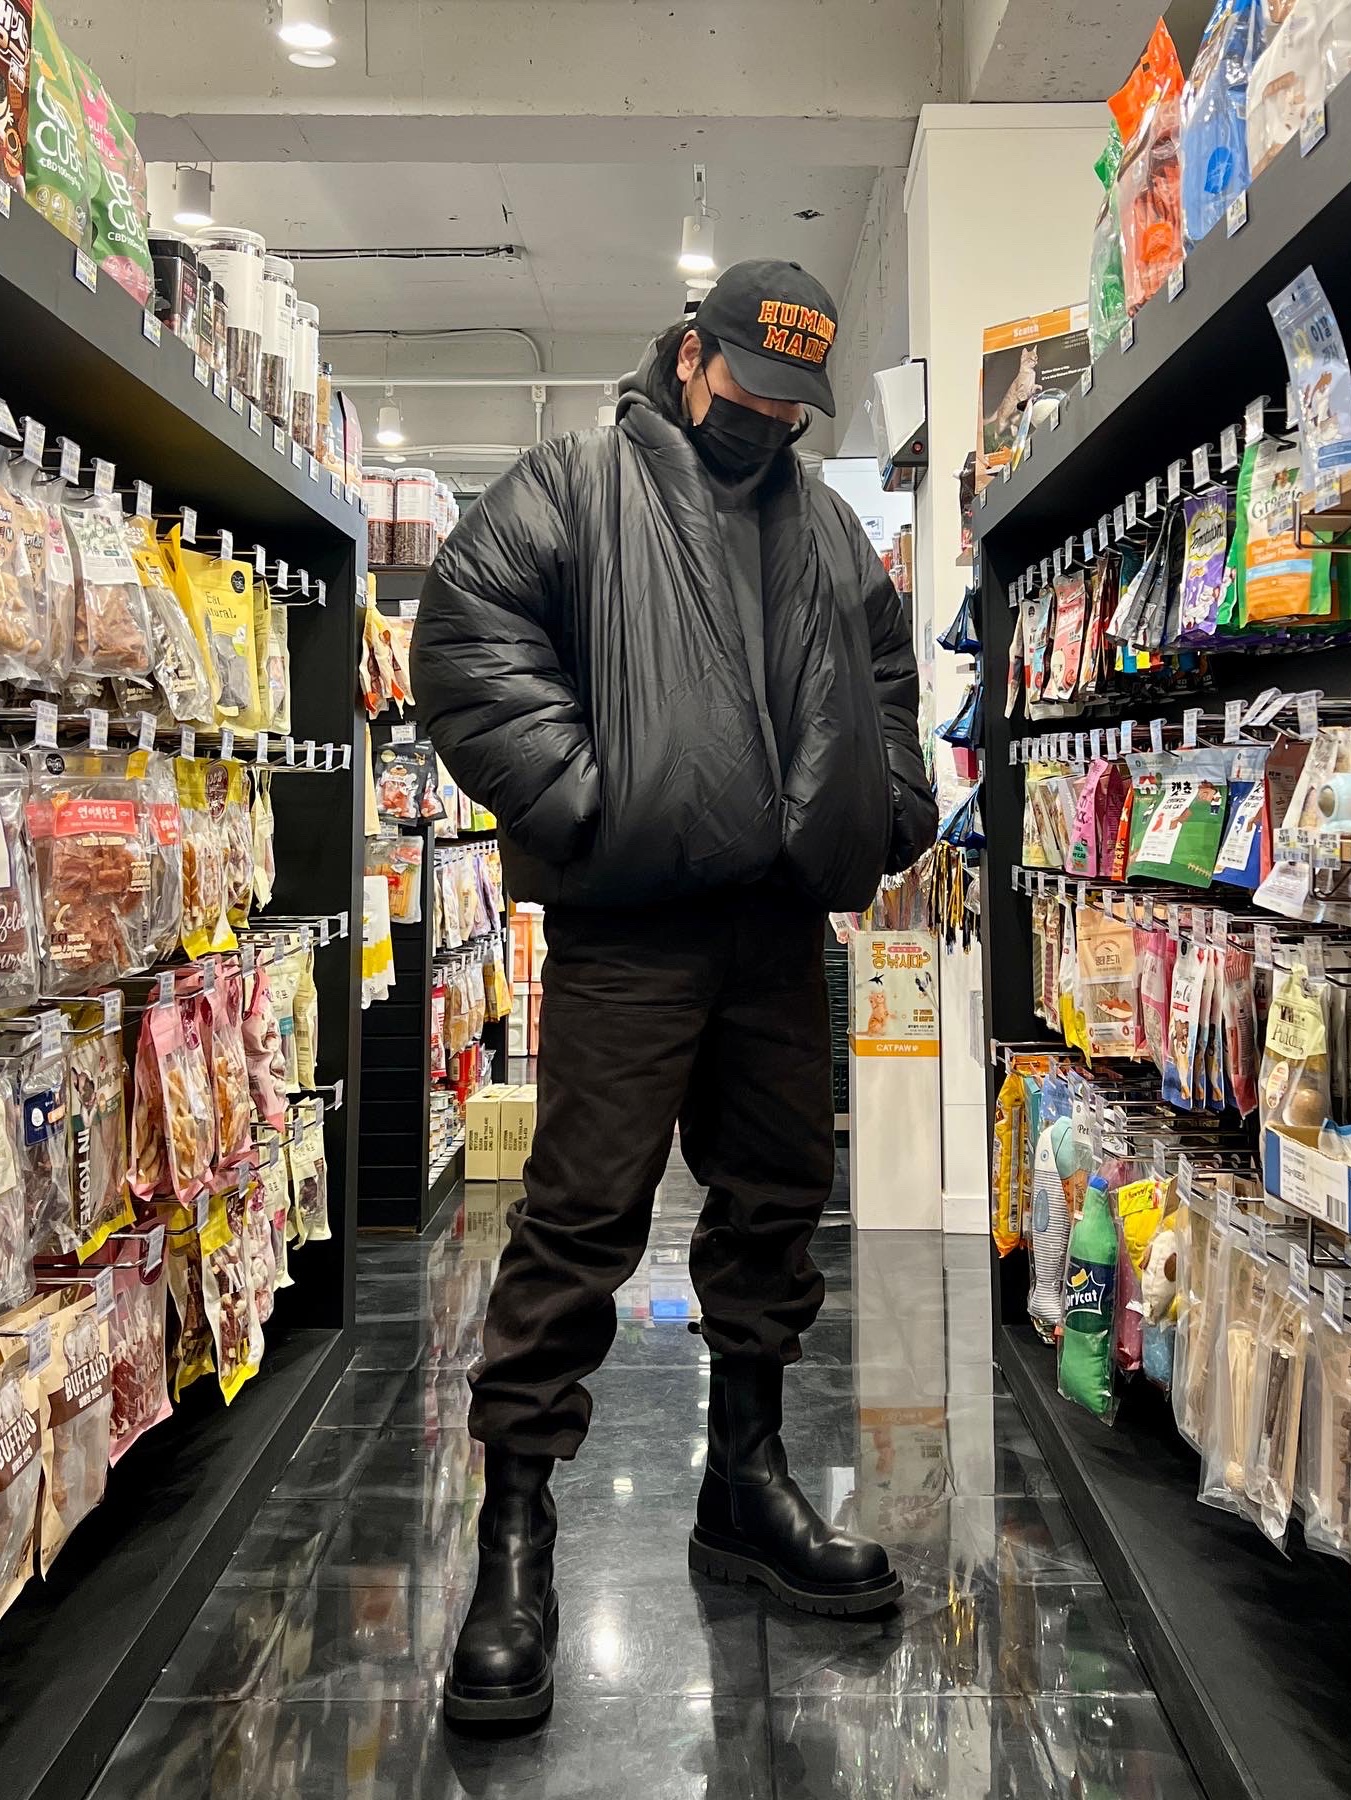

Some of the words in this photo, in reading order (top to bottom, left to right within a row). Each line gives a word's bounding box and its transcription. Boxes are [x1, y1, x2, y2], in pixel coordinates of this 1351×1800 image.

[758, 300, 835, 345] HUMAN
[763, 325, 828, 364] MADE
[64, 1353, 108, 1402] BUFFALO
